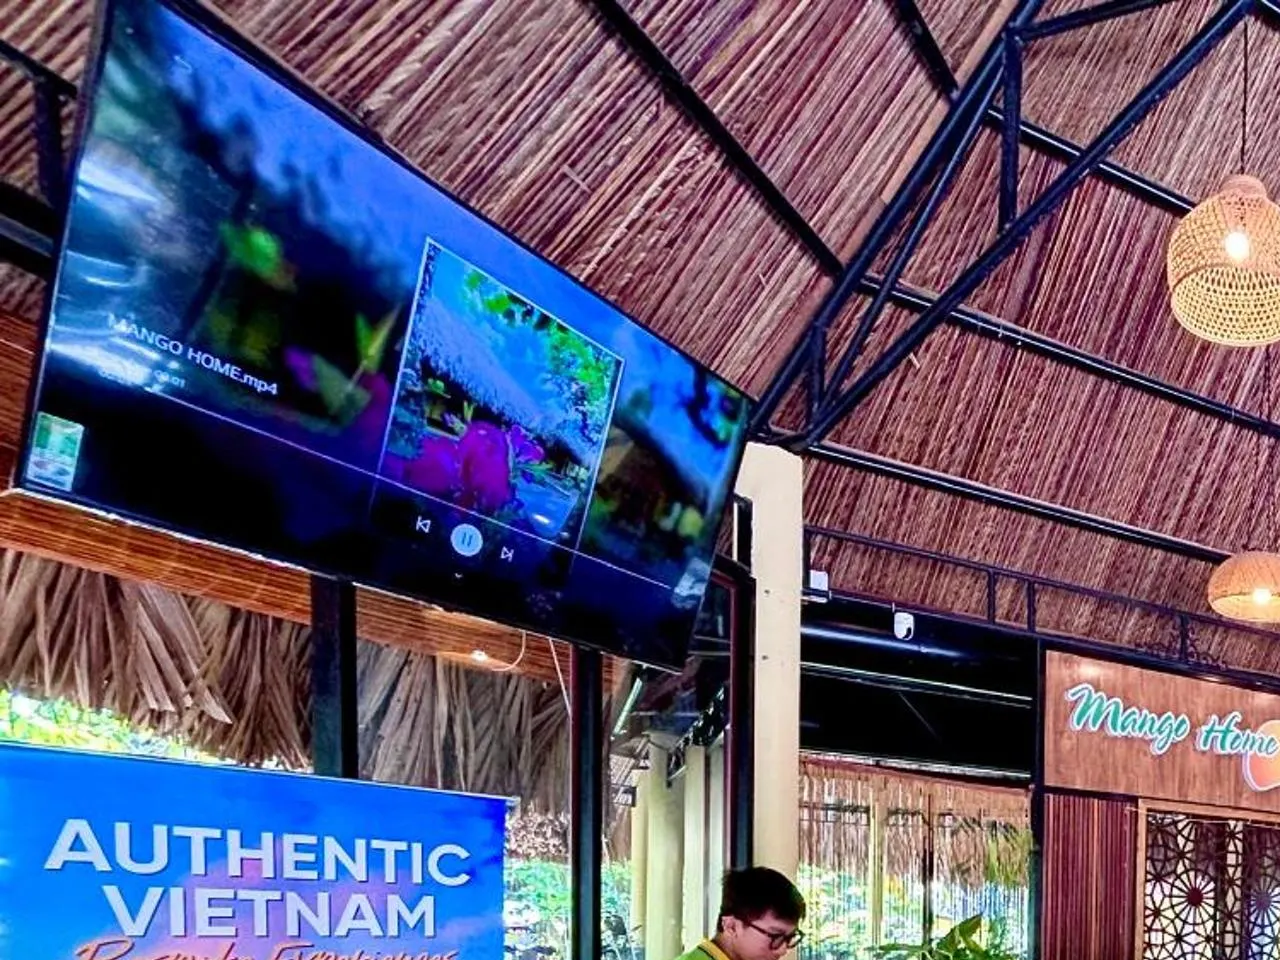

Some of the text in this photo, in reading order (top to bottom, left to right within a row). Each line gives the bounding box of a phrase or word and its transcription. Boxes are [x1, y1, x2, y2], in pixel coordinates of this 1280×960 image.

[187, 348, 278, 395] HOME.mp4
[1066, 683, 1280, 757] Mango Home
[44, 818, 471, 886] AUTHENTIC
[102, 885, 436, 939] VIETNAM
